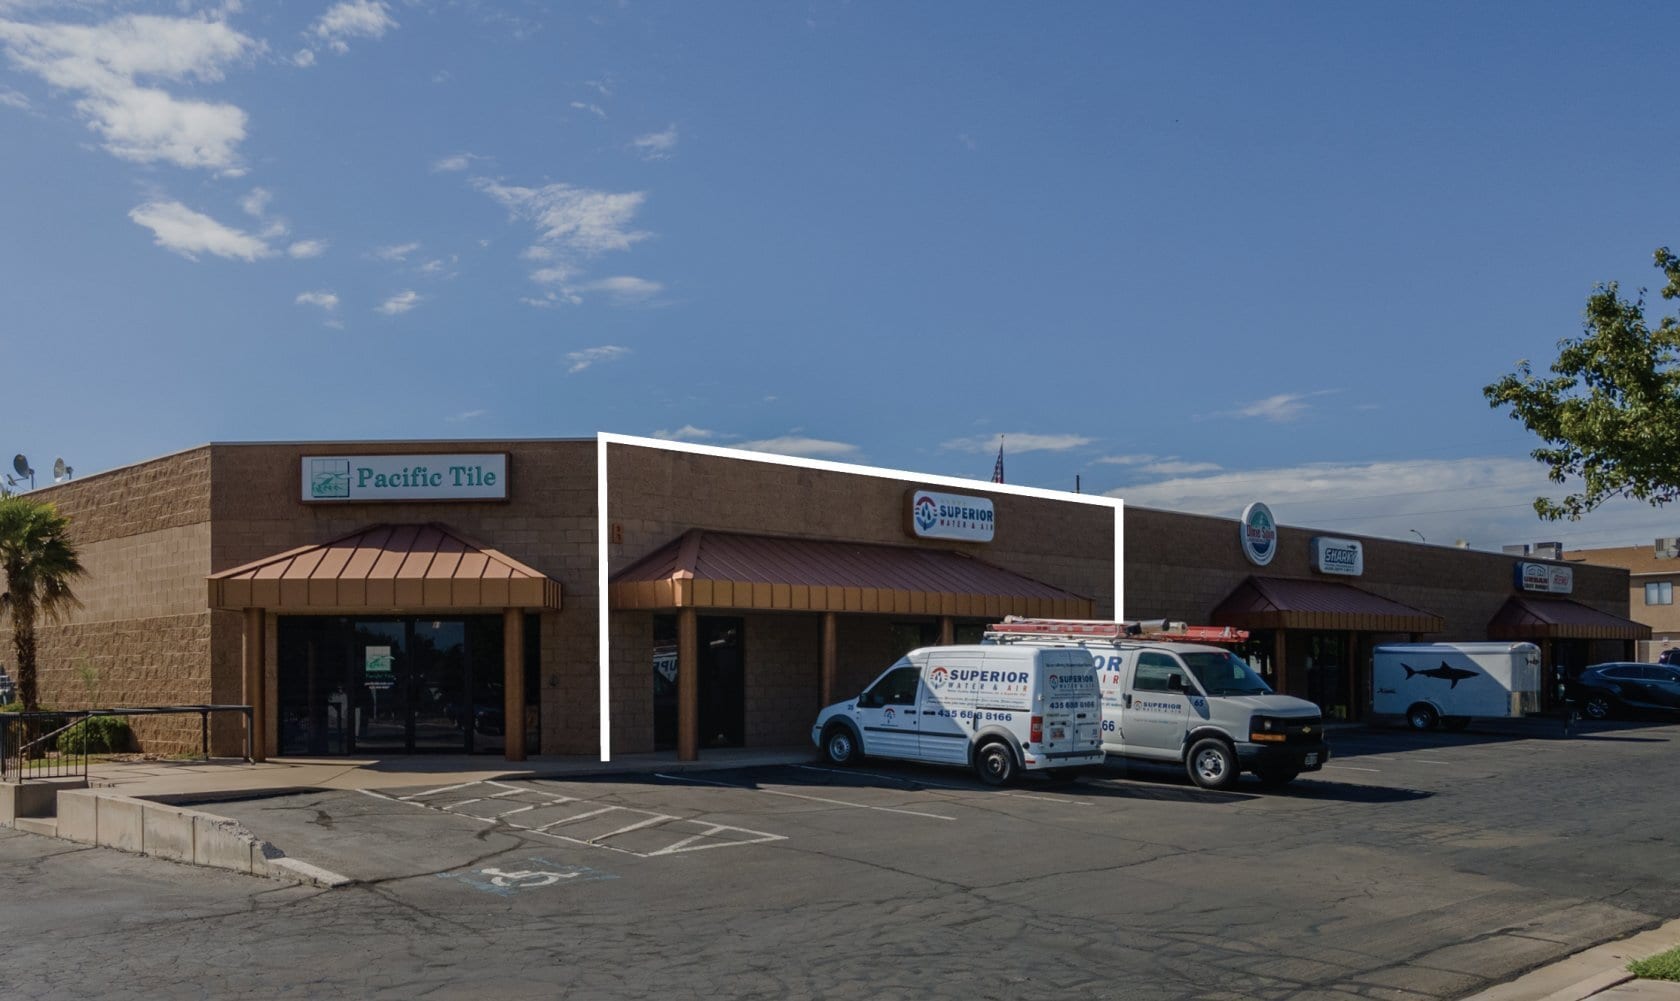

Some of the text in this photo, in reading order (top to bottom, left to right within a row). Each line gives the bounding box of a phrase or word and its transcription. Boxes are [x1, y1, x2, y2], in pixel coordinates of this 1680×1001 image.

[356, 466, 496, 488] Pacific Tile
[940, 505, 993, 522] SUPERIOR
[1324, 547, 1359, 565] SHARKY
[949, 669, 1029, 684] SUPERIOR
[1059, 675, 1094, 683] SUPERIOR
[948, 682, 985, 690] WATER
[1007, 684, 1028, 692] AIR
[1049, 701, 1064, 709] 435
[1143, 701, 1182, 710] SUPERIOR
[937, 709, 958, 718] 435
[985, 712, 1012, 721] 8166
[1101, 720, 1115, 732] 66
